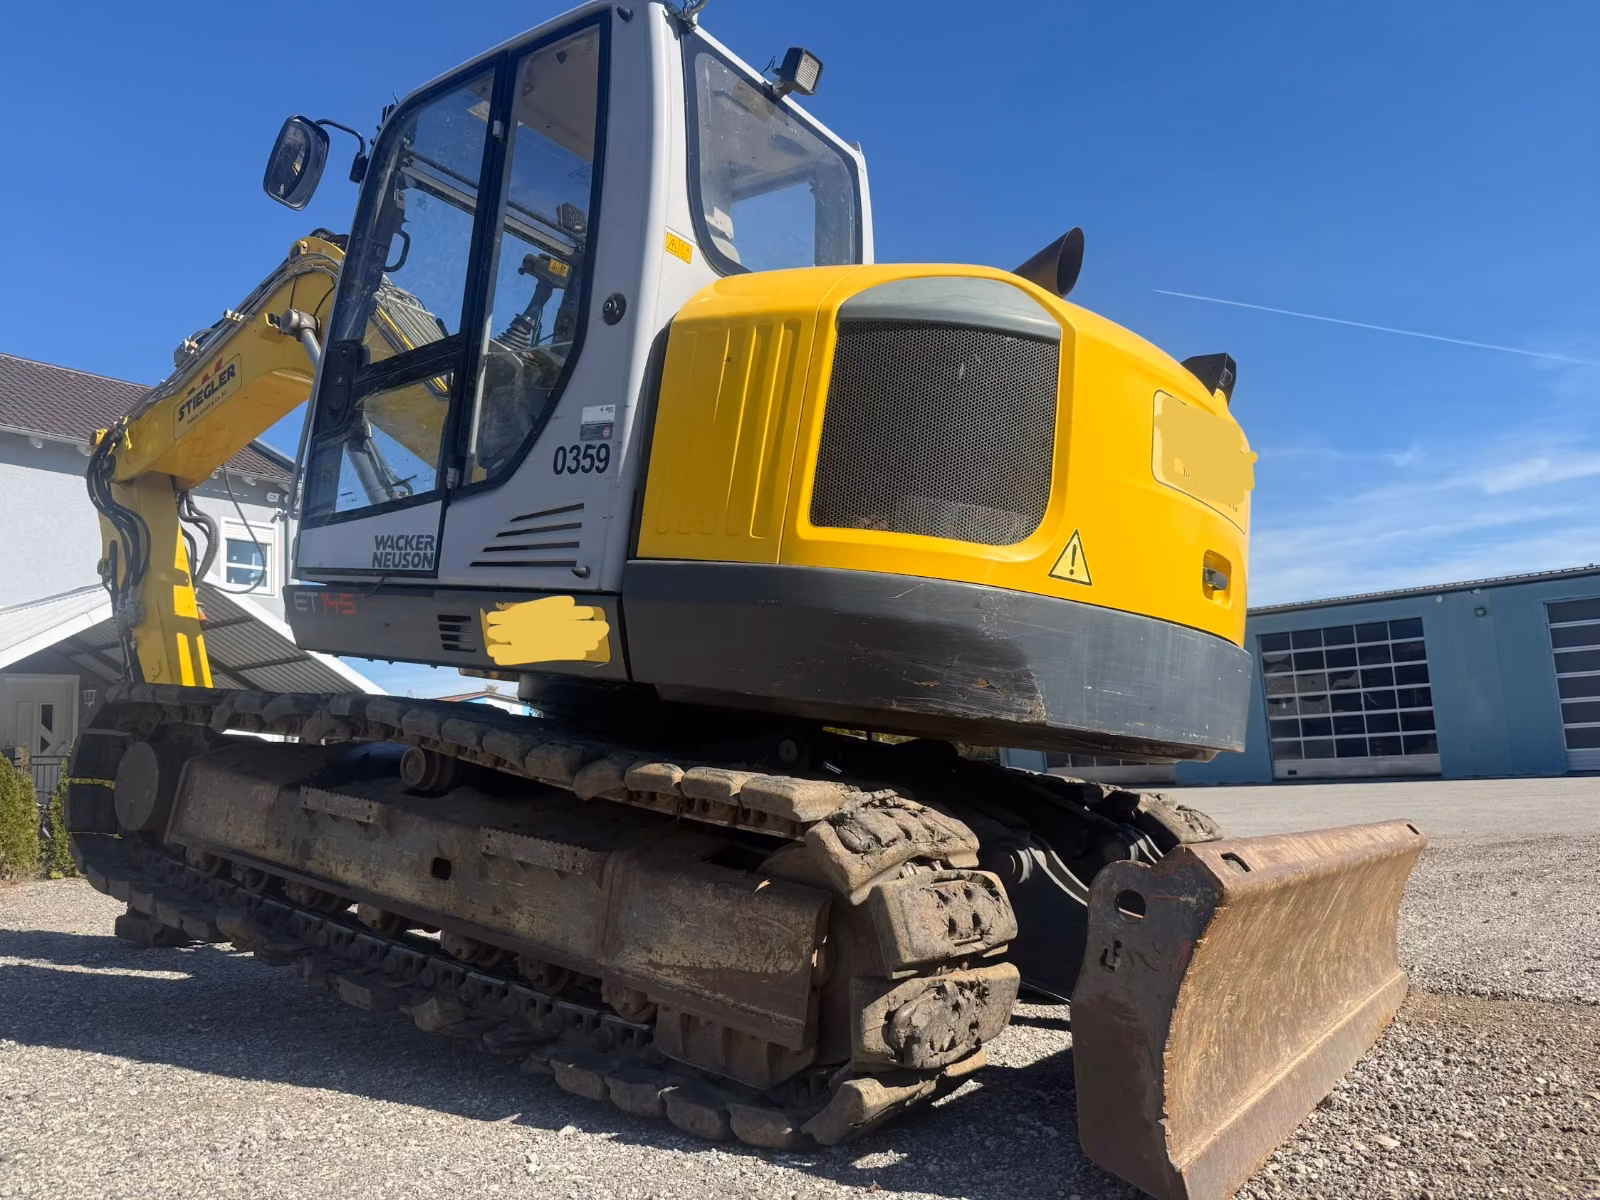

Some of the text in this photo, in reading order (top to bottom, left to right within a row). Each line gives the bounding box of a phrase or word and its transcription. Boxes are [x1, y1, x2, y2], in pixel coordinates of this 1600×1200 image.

[178, 364, 236, 422] STIEGLER
[553, 443, 611, 475] 0359
[374, 534, 435, 551] WACKER
[371, 552, 434, 569] NEUSON
